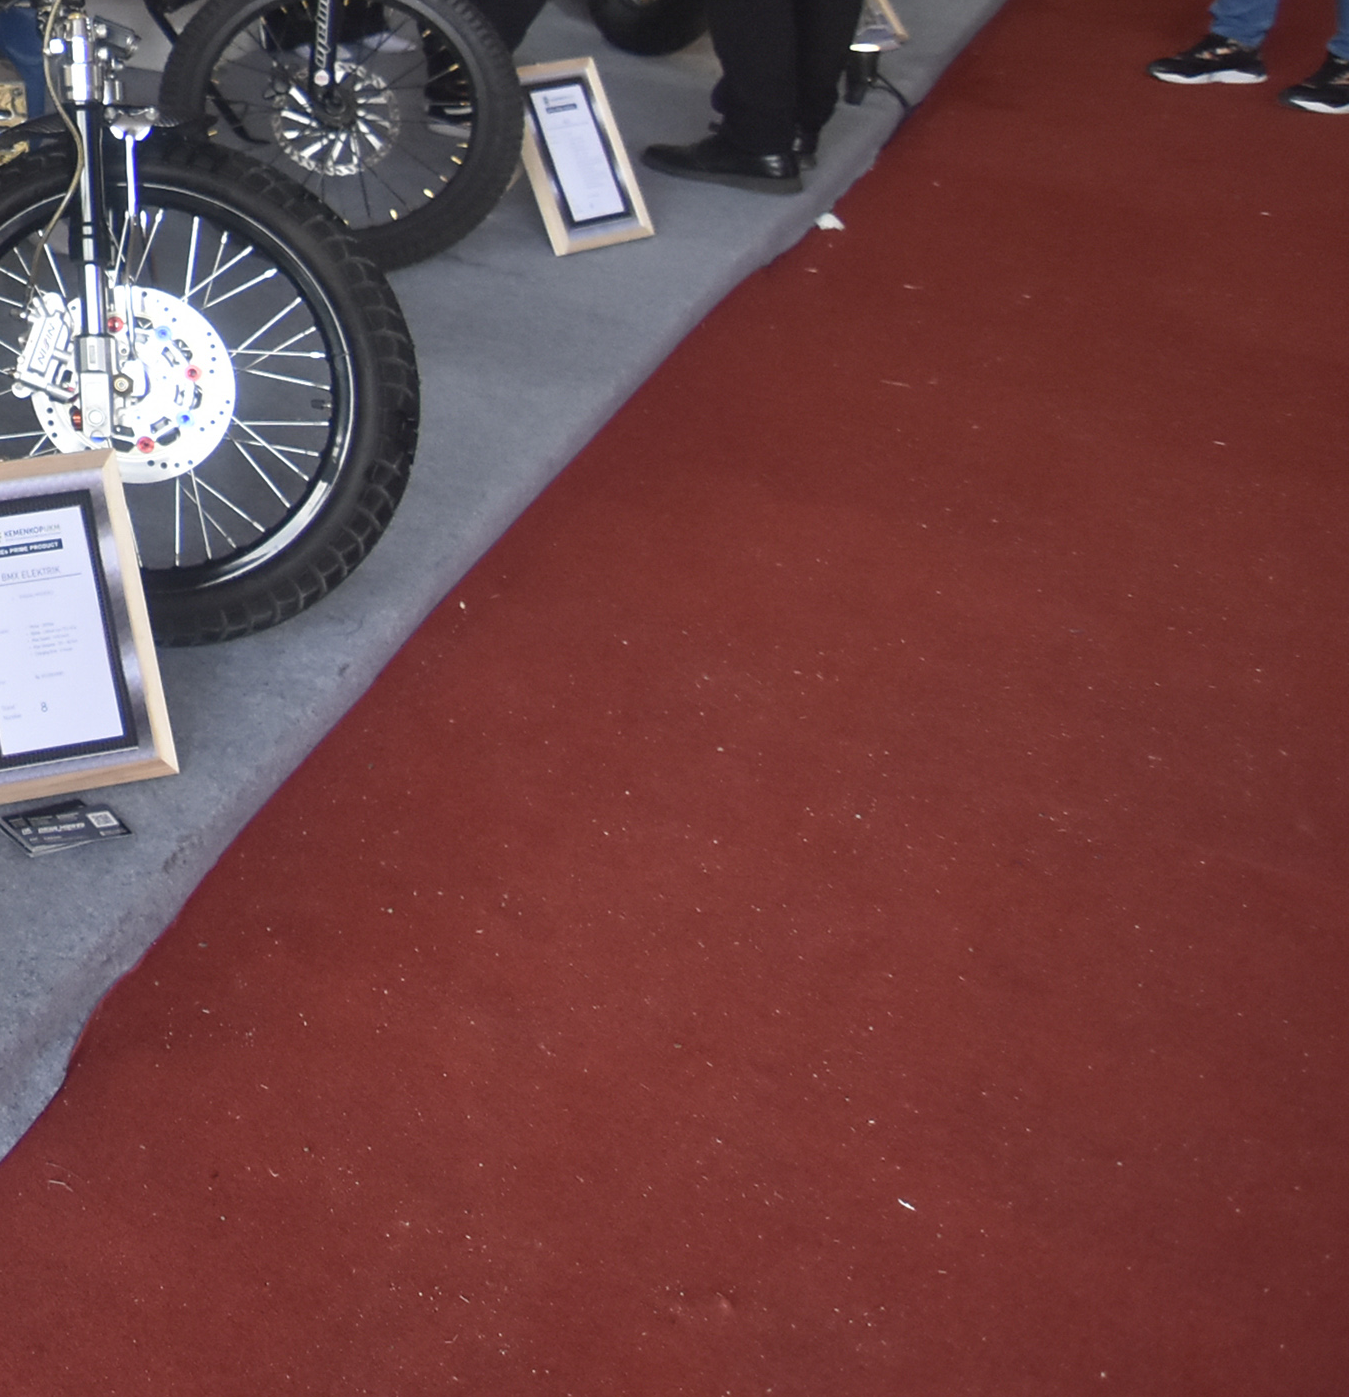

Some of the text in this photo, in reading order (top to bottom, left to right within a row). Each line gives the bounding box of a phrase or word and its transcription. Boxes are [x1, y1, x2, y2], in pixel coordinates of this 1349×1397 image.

[29, 542, 58, 550] PRODUCT
[20, 565, 61, 579] ELEKTRIK
[40, 701, 49, 713] 8
